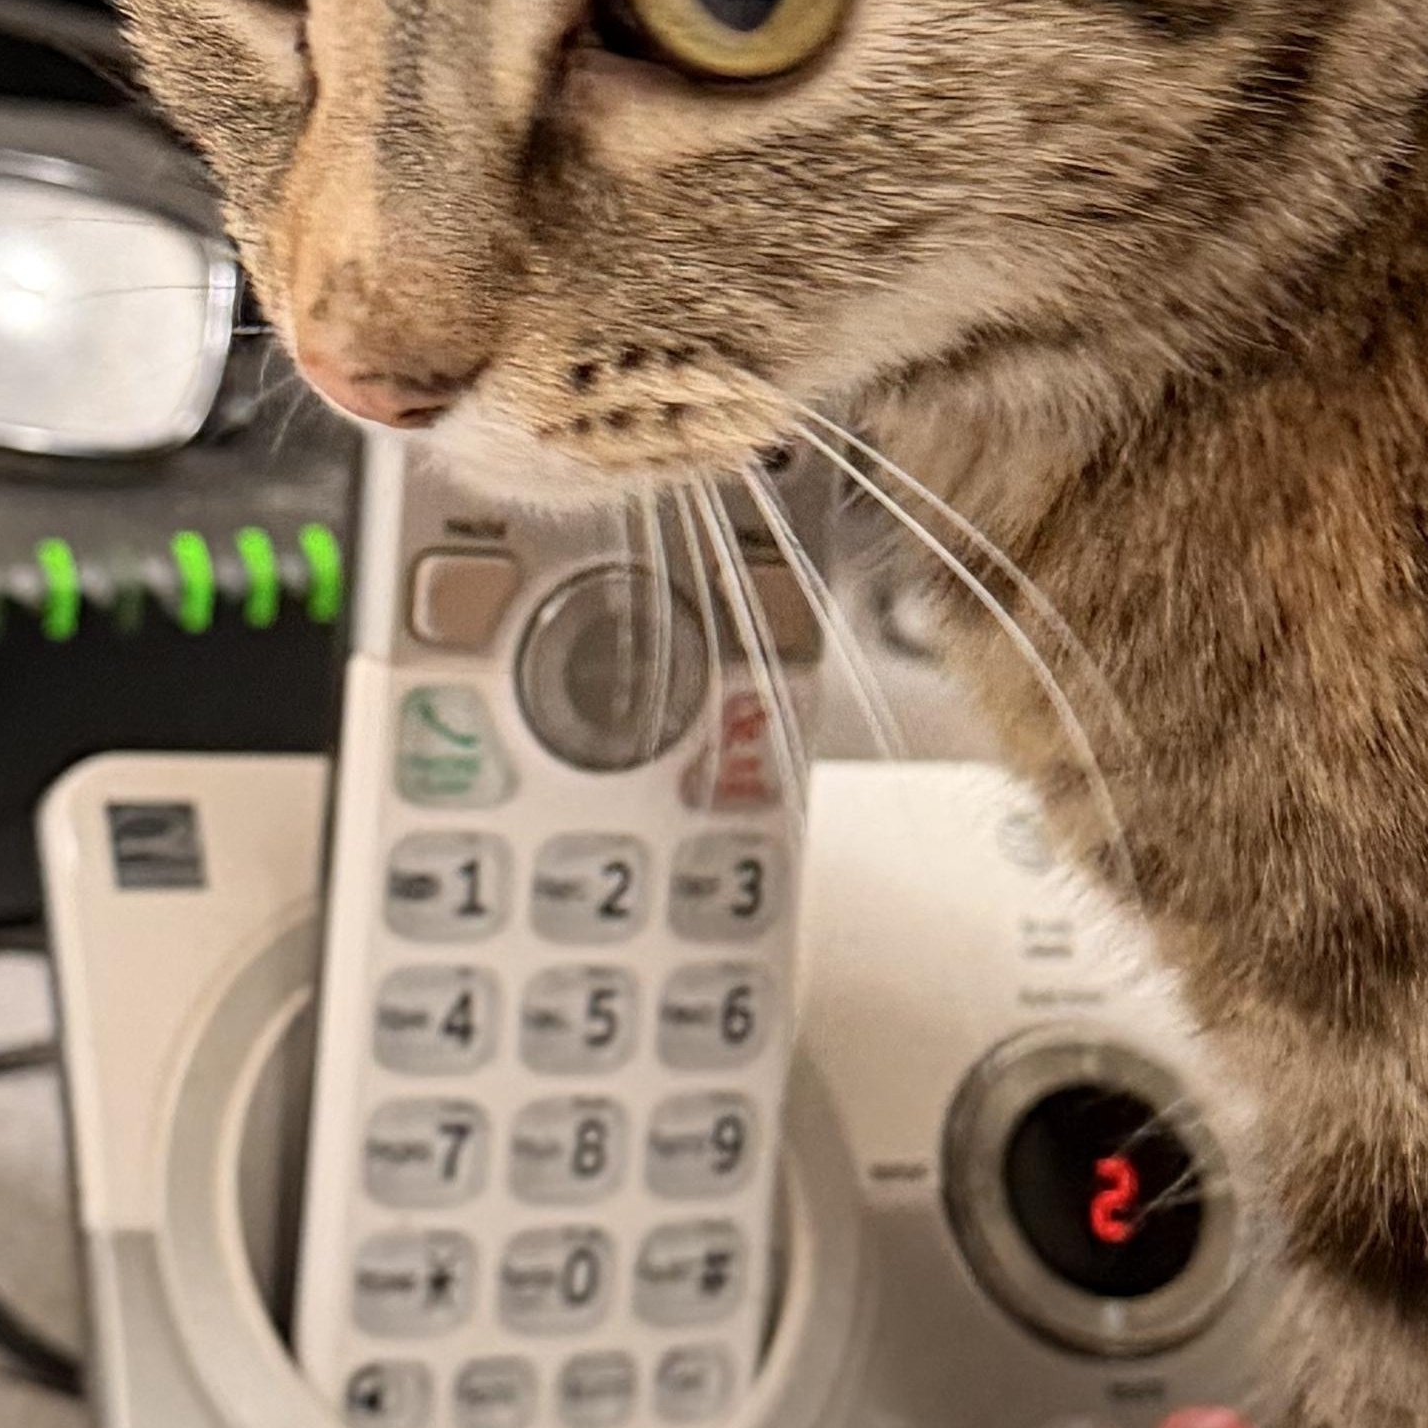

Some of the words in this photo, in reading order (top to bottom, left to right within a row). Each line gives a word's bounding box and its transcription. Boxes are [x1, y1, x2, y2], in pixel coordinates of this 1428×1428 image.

[455, 858, 486, 918] 1
[597, 860, 631, 919] 2
[730, 857, 763, 919] 3
[440, 990, 474, 1047] 4
[583, 988, 617, 1048] 5
[720, 985, 753, 1045] 6
[439, 1123, 472, 1181] 7
[573, 1117, 606, 1179] 8
[710, 1113, 745, 1176] 9
[1089, 1154, 1139, 1243] 2
[562, 1246, 599, 1306] 0
